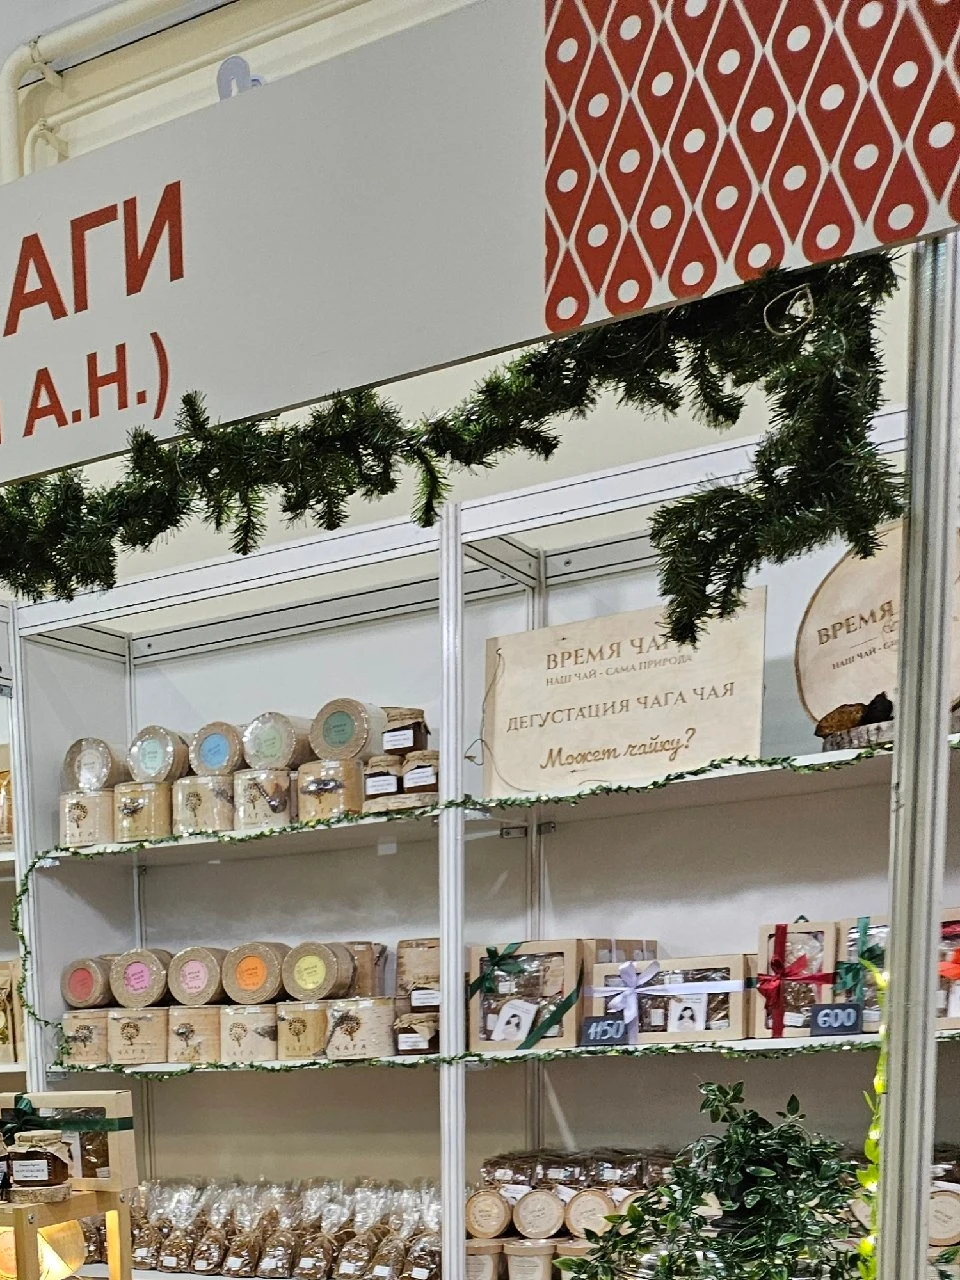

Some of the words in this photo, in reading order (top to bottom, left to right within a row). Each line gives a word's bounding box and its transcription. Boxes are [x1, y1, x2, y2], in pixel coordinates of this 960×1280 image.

[22, 331, 170, 438] А.Н.)
[817, 600, 894, 645] ВРЕМЯ
[546, 642, 622, 670] ВРЕМЯ
[546, 675, 574, 686] НАШ
[575, 668, 597, 681] ЧАЙ
[605, 663, 635, 676] САМА
[639, 655, 692, 671] ПРИРОДА
[833, 655, 855, 669] НАШ
[507, 699, 630, 733] ДЕГУСТАЦИЯ
[636, 691, 687, 709] ЧАГА
[692, 682, 735, 701] ЧАЯ
[540, 747, 619, 769] Может
[623, 728, 696, 761] чайку?
[817, 1008, 857, 1028] 600
